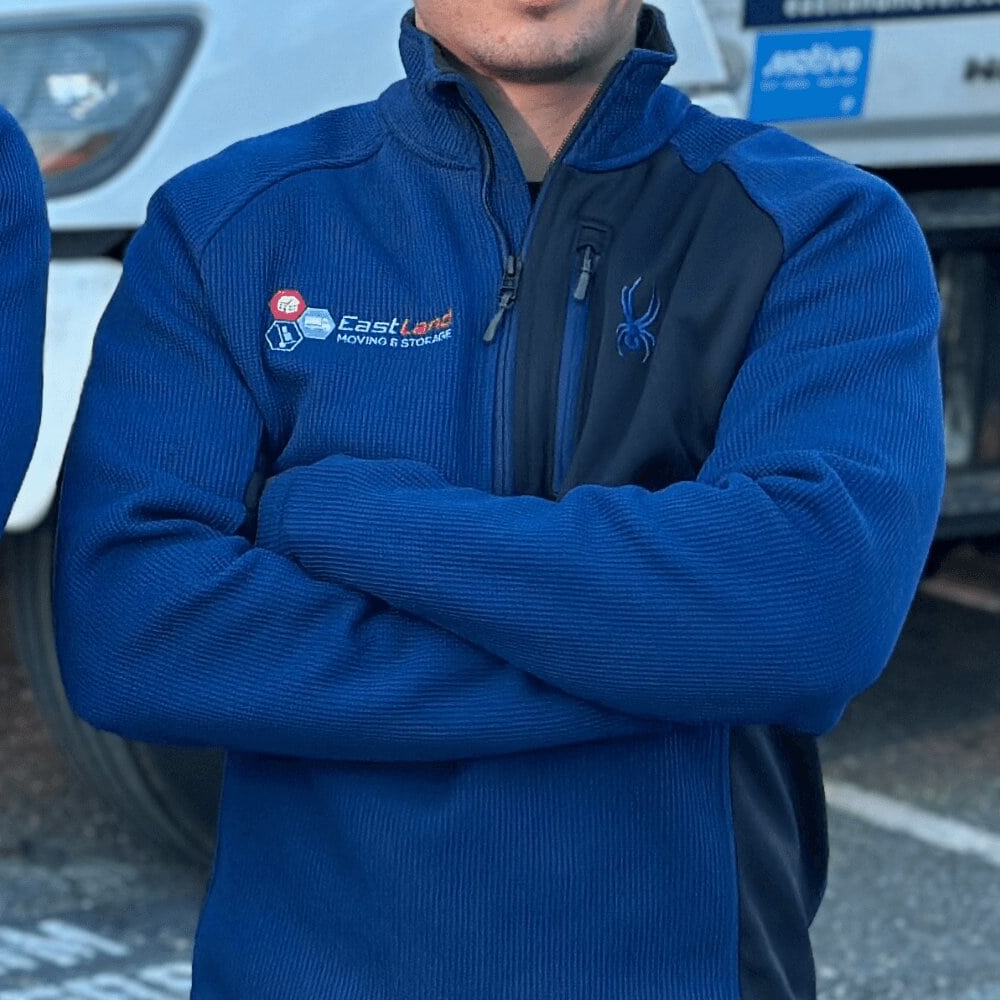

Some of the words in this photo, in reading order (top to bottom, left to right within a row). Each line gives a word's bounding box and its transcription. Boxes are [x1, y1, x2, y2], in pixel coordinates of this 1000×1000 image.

[338, 308, 453, 336] EastLand
[336, 334, 387, 346] MOVING
[400, 328, 453, 348] STORAGE
